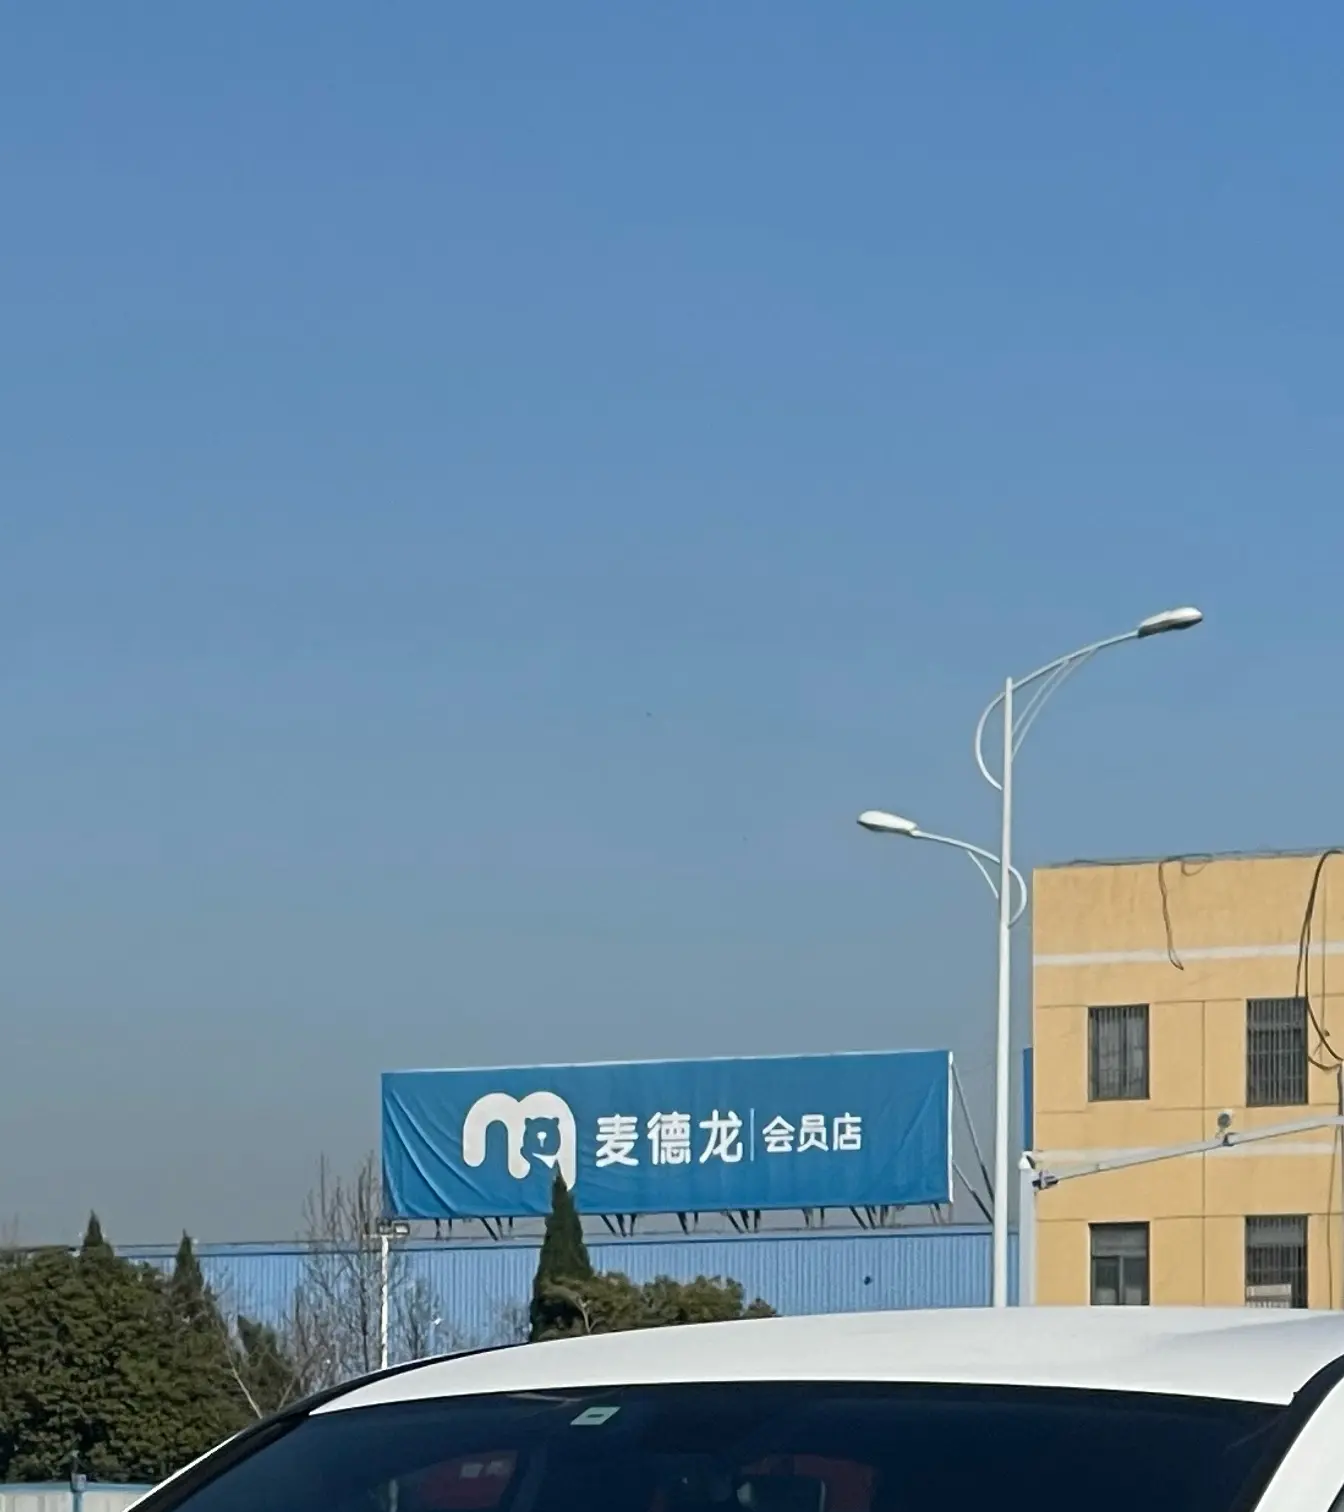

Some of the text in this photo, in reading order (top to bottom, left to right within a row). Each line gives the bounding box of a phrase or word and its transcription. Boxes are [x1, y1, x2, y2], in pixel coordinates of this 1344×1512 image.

[594, 1110, 863, 1168] 麦德龙 会员店
